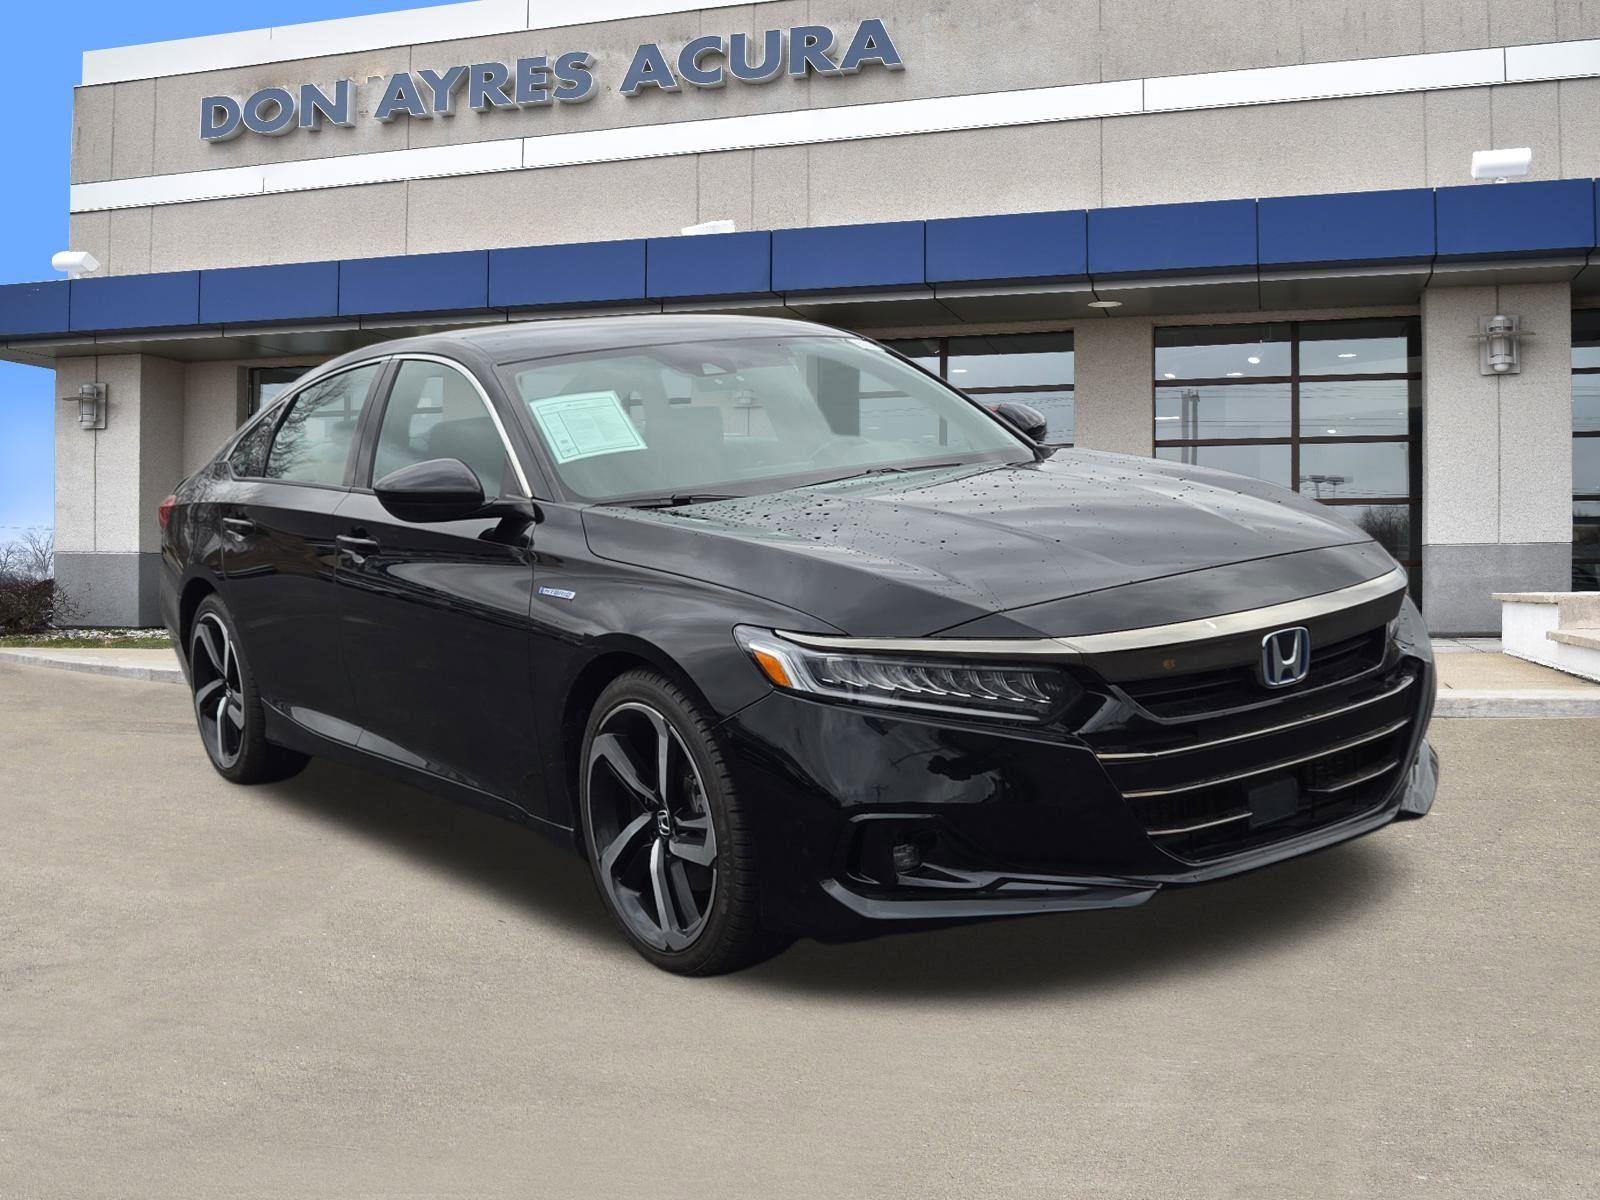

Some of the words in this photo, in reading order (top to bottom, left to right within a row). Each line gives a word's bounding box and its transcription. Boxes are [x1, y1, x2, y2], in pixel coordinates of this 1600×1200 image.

[200, 79, 354, 143] DON
[374, 51, 596, 122] AYRES
[619, 18, 905, 97] ACURA
